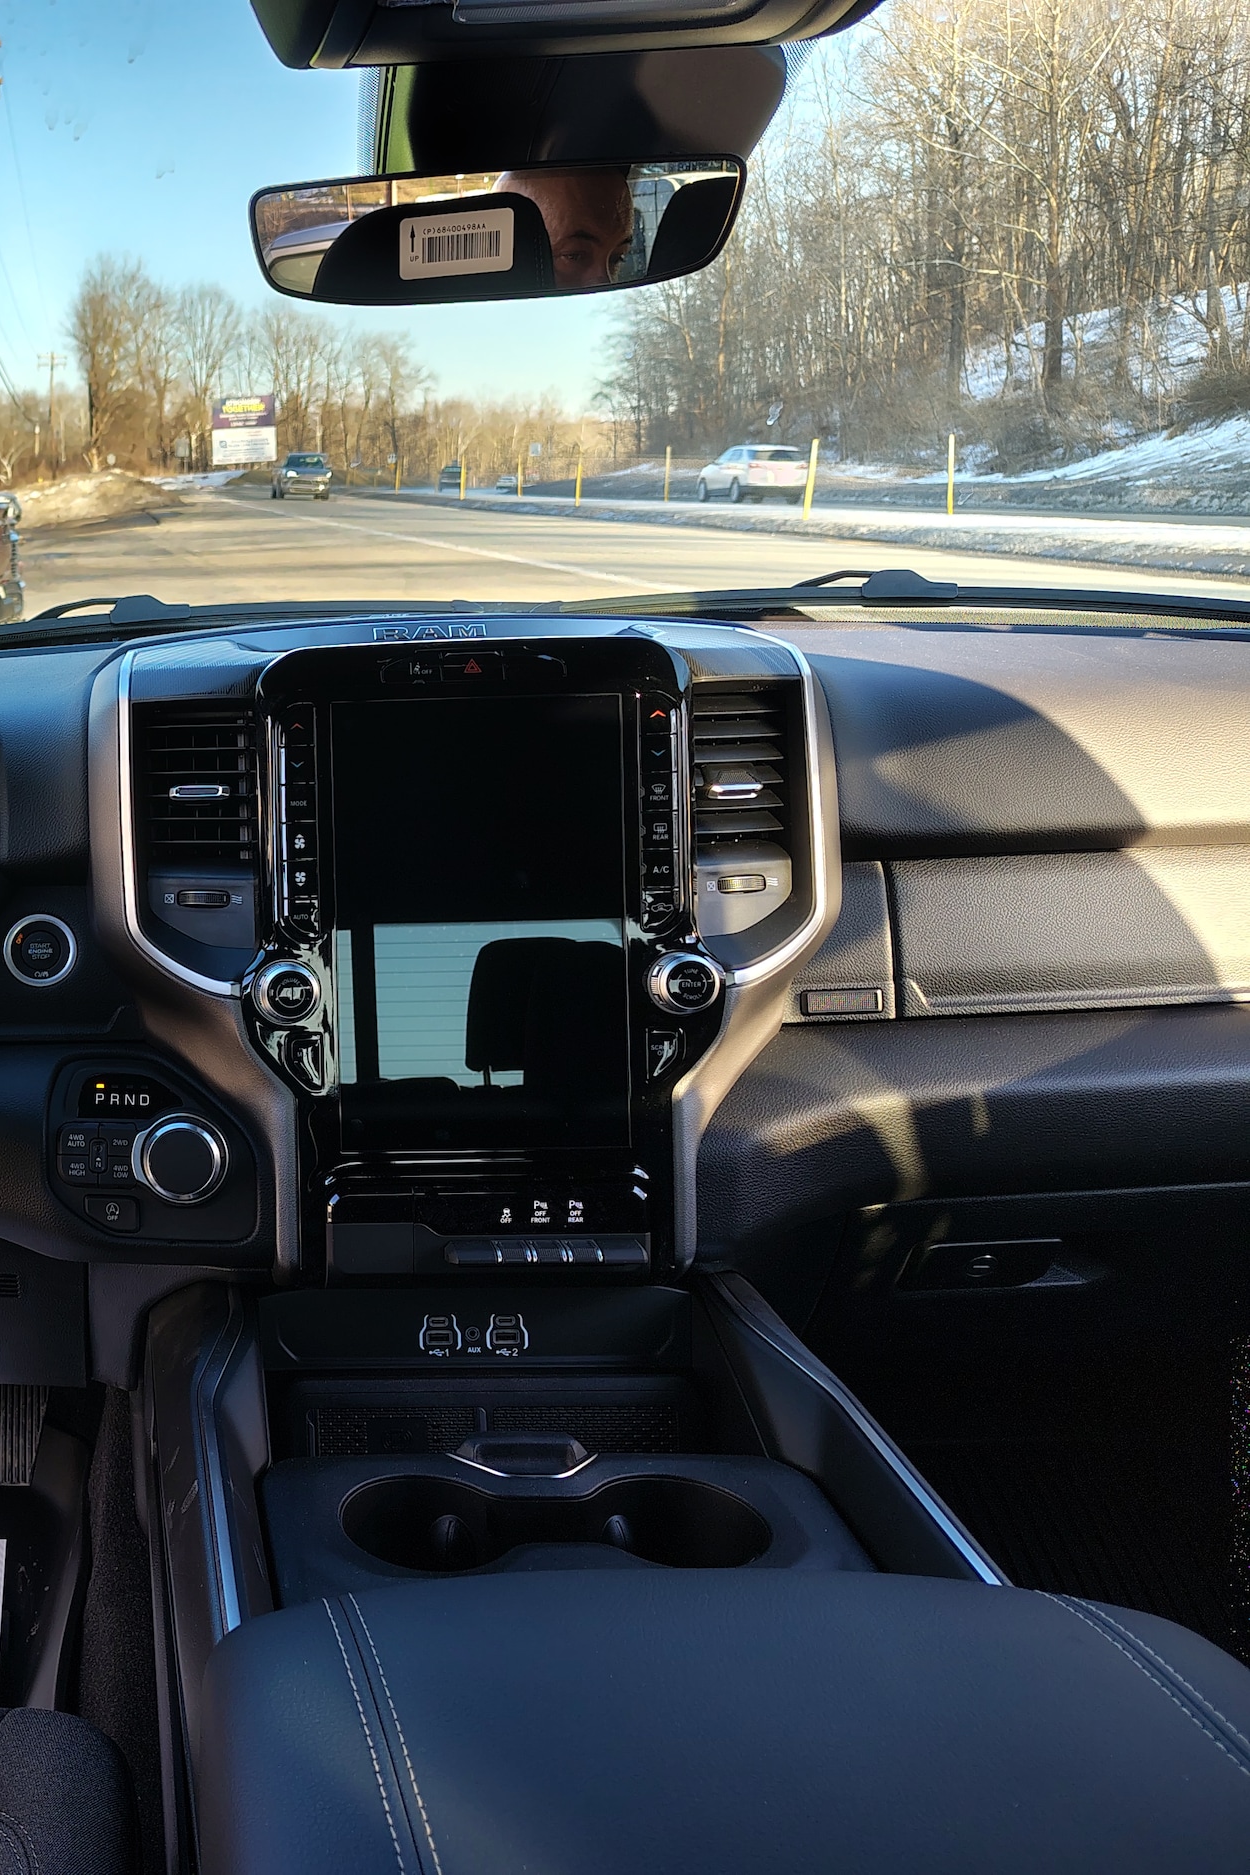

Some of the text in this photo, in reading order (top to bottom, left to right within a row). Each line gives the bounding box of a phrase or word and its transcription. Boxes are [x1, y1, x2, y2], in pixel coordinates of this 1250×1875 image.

[422, 223, 487, 235] (P)68400498AA
[373, 624, 486, 640] RAM
[653, 866, 670, 874] A/C
[67, 1140, 86, 1148] AUTO
[68, 1169, 86, 1177] HIGH
[445, 1349, 449, 1357] 1
[512, 1348, 518, 1356] 2
